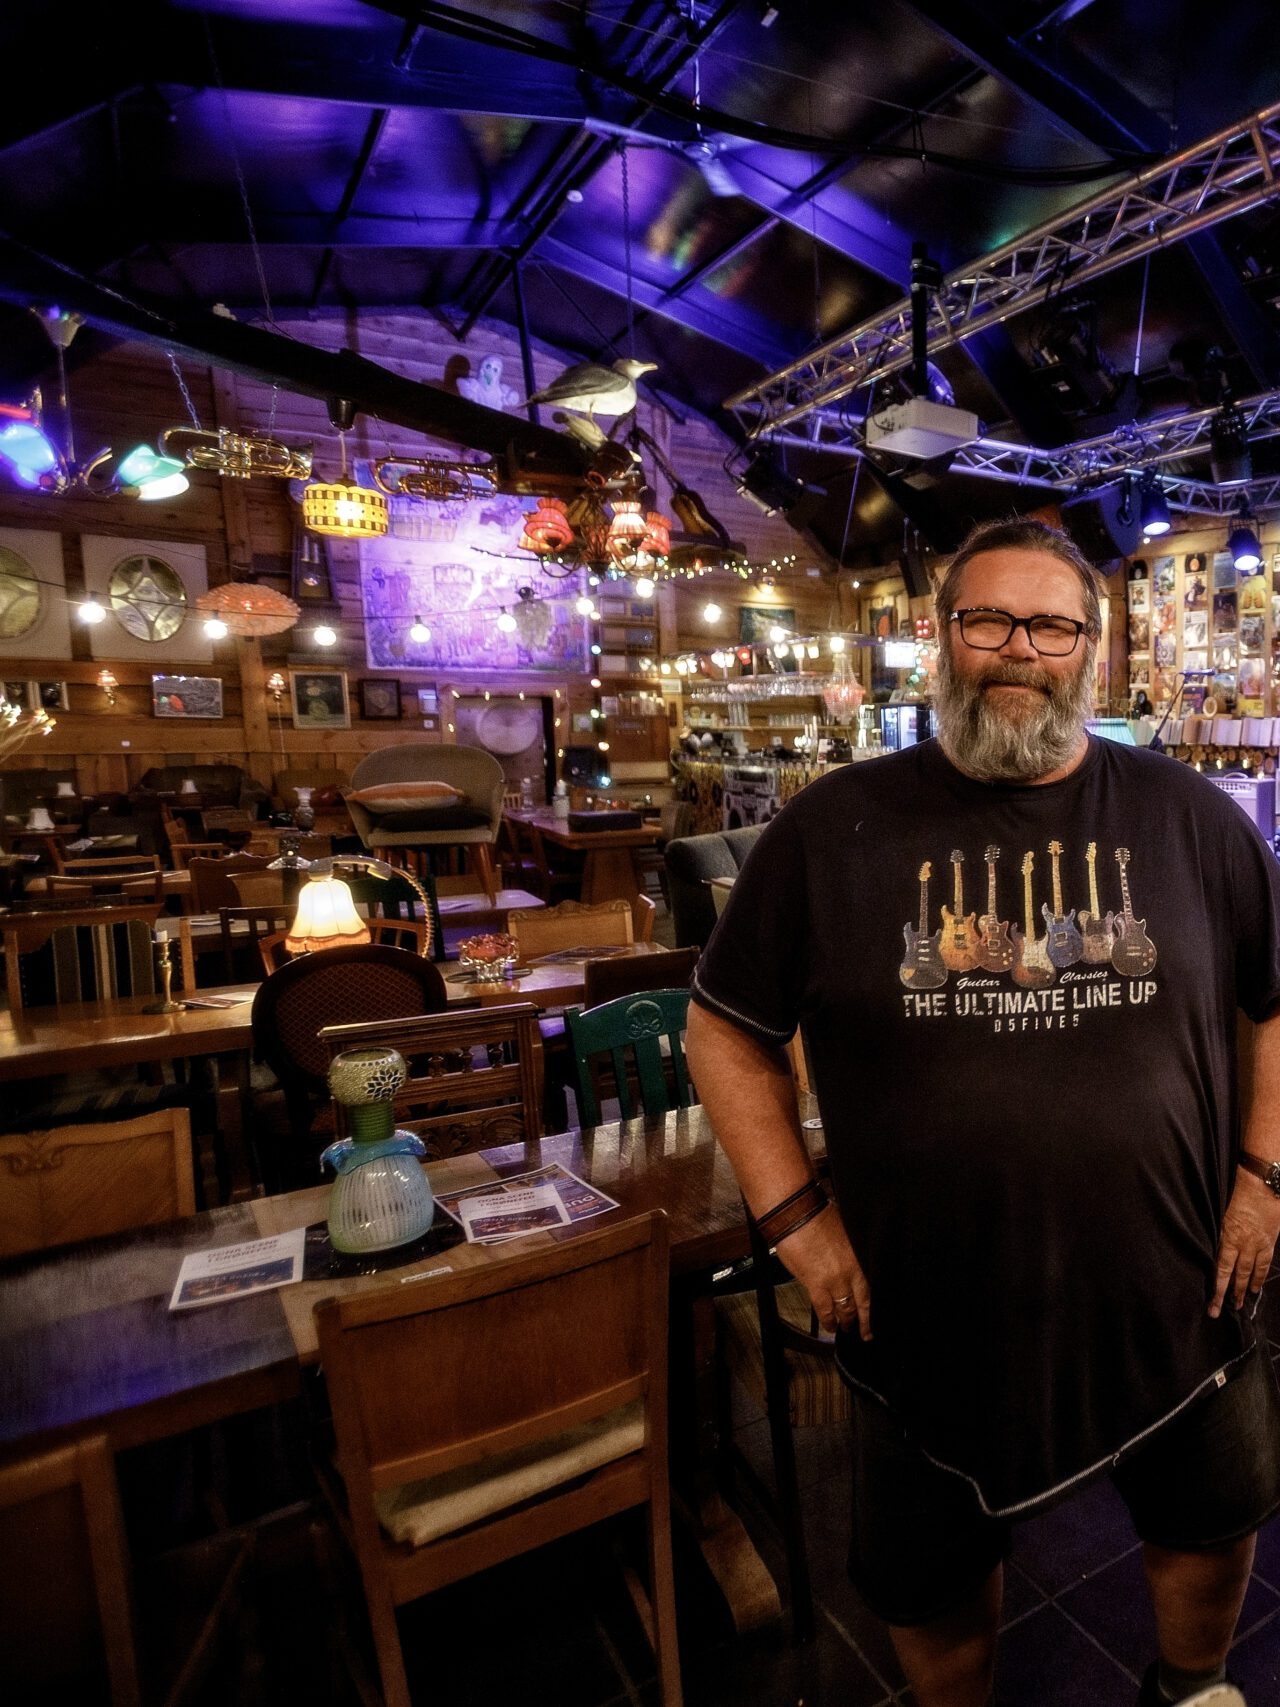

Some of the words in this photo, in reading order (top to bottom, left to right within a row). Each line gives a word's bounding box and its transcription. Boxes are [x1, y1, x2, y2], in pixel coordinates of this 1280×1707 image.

[956, 976, 1001, 989] Guitar
[1059, 970, 1109, 985] Classics
[903, 993, 948, 1018] THE
[955, 988, 1066, 1017] ULTIMATE
[1073, 981, 1122, 1008] LINE
[1129, 981, 1158, 1005] UP
